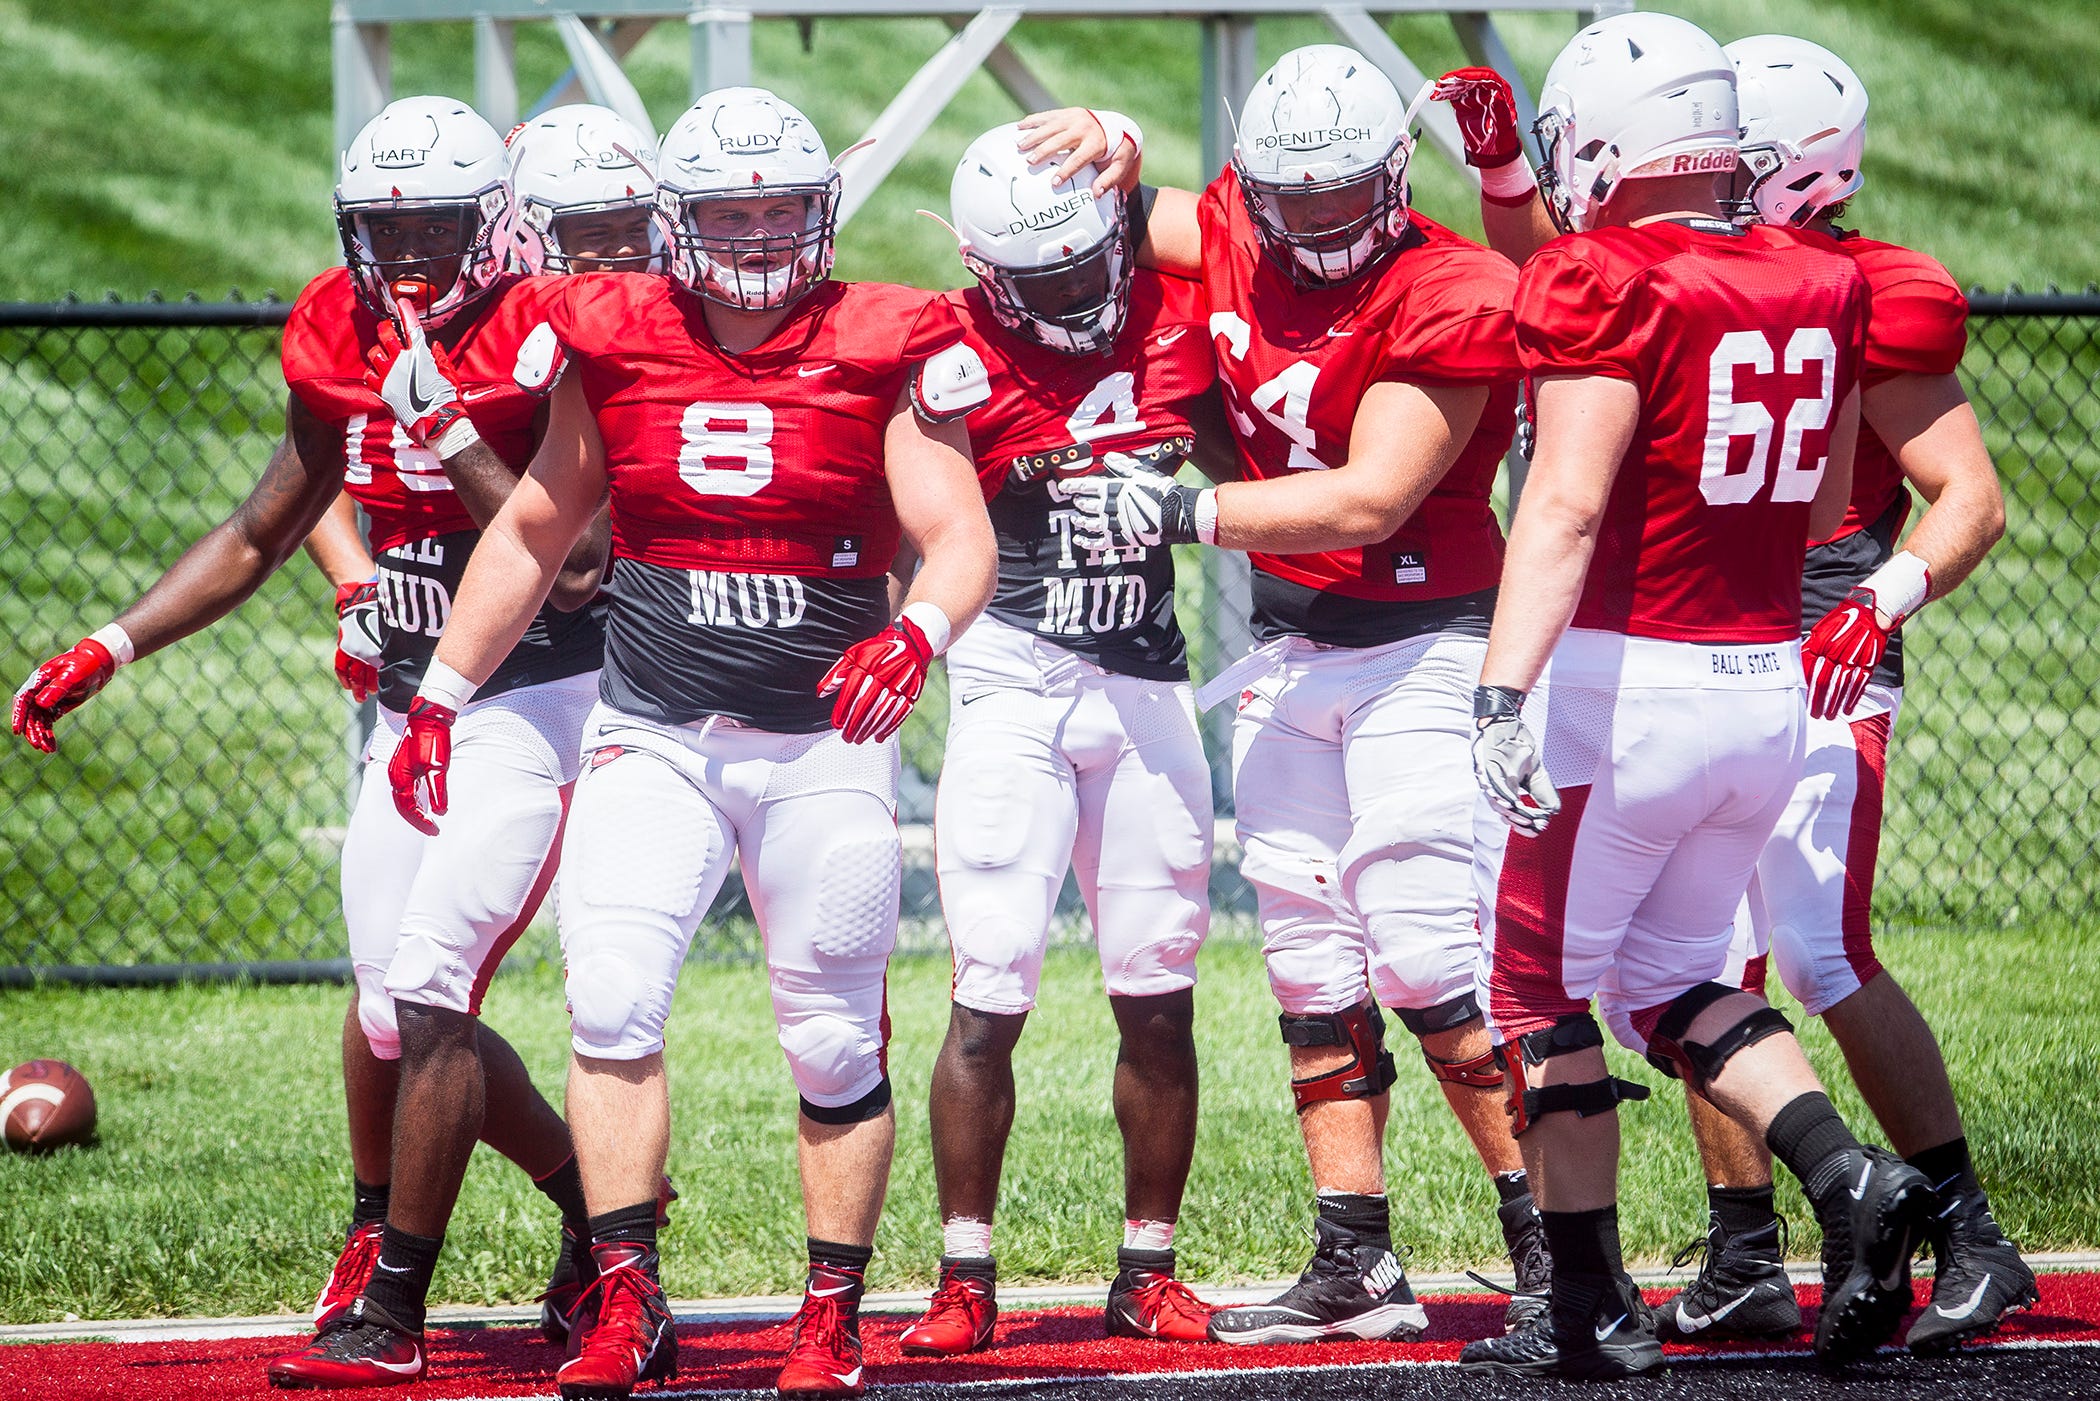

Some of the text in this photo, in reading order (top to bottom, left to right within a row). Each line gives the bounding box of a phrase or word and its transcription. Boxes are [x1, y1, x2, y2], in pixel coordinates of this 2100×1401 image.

[719, 134, 783, 150] RUDY
[1256, 127, 1371, 150] POENITSCH
[371, 149, 430, 163] HART
[1009, 192, 1093, 235] DUNNER
[1065, 371, 1147, 443] 4
[1698, 328, 1837, 506] 62
[678, 400, 774, 497] 8
[843, 539, 852, 550] S
[1400, 554, 1418, 565] XL
[686, 568, 806, 628] MUD
[1037, 574, 1147, 634] MUD
[1712, 652, 1780, 674] BALL STATE
